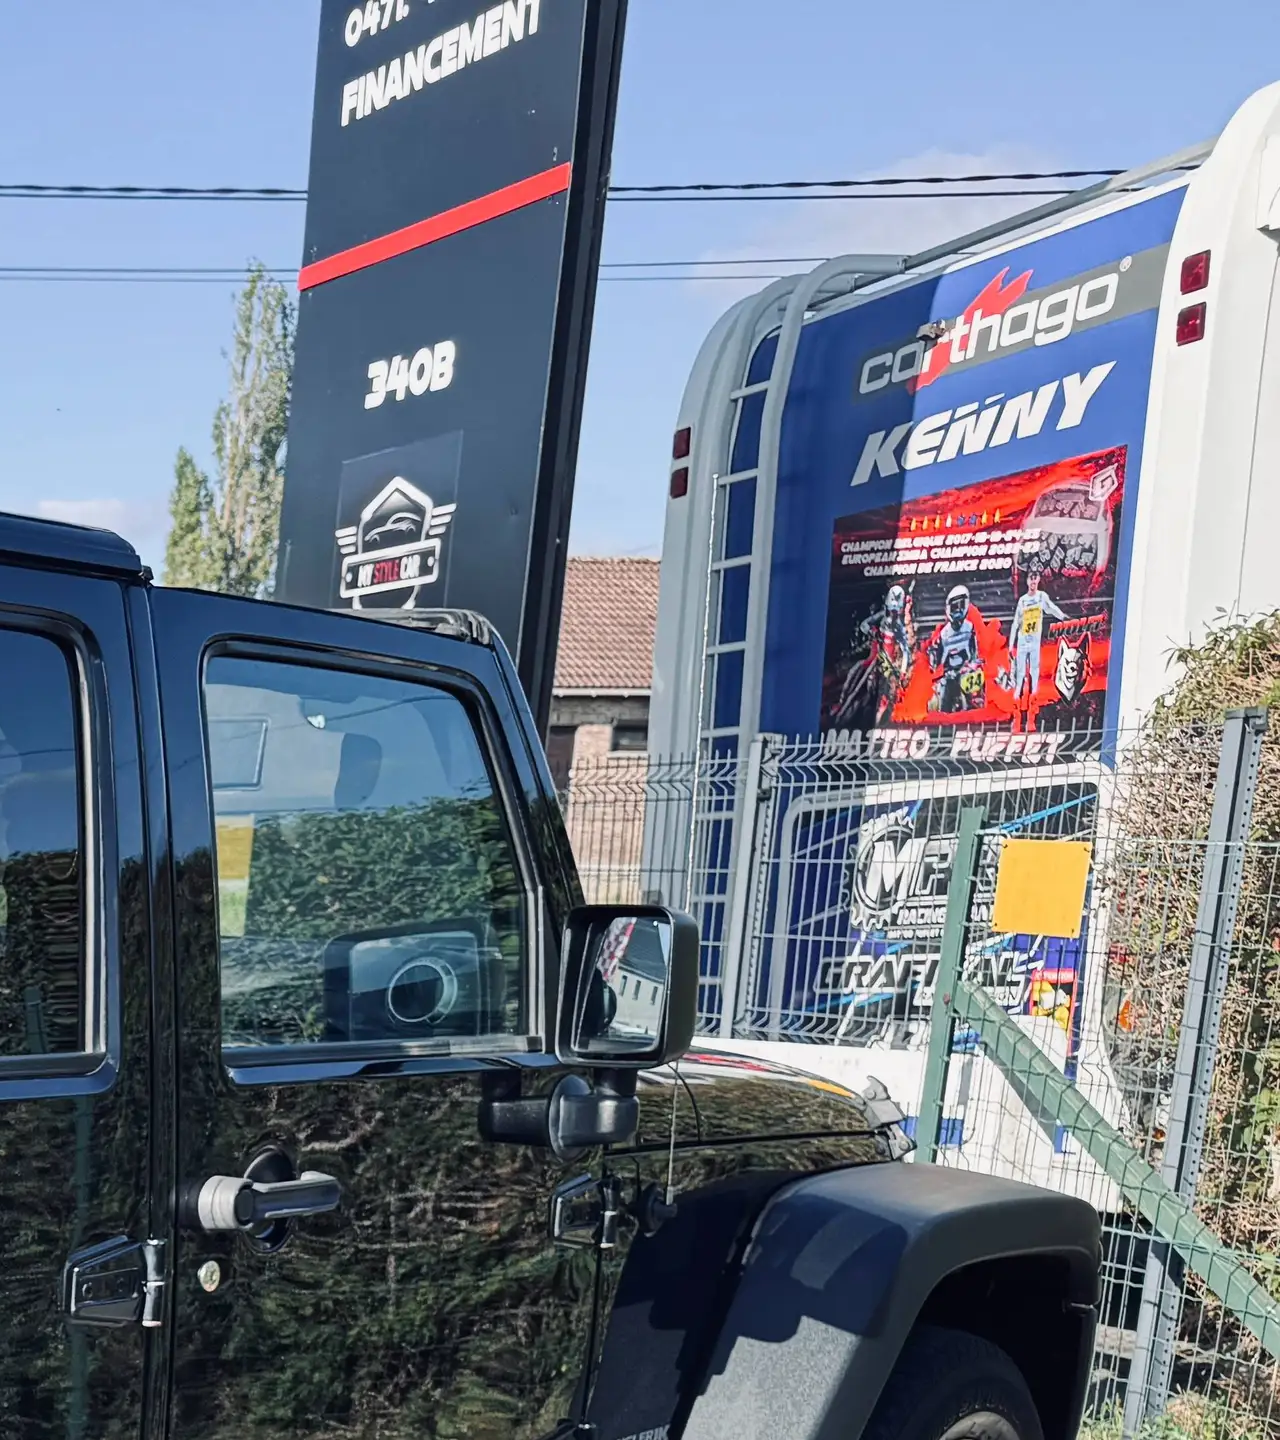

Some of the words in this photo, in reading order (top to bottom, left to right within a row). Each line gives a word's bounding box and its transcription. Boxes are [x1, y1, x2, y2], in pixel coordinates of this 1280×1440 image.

[341, 0, 540, 127] FINANCEMENT
[364, 341, 456, 410] 340B
[859, 272, 1119, 394] carthago
[850, 360, 1117, 487] KENNY
